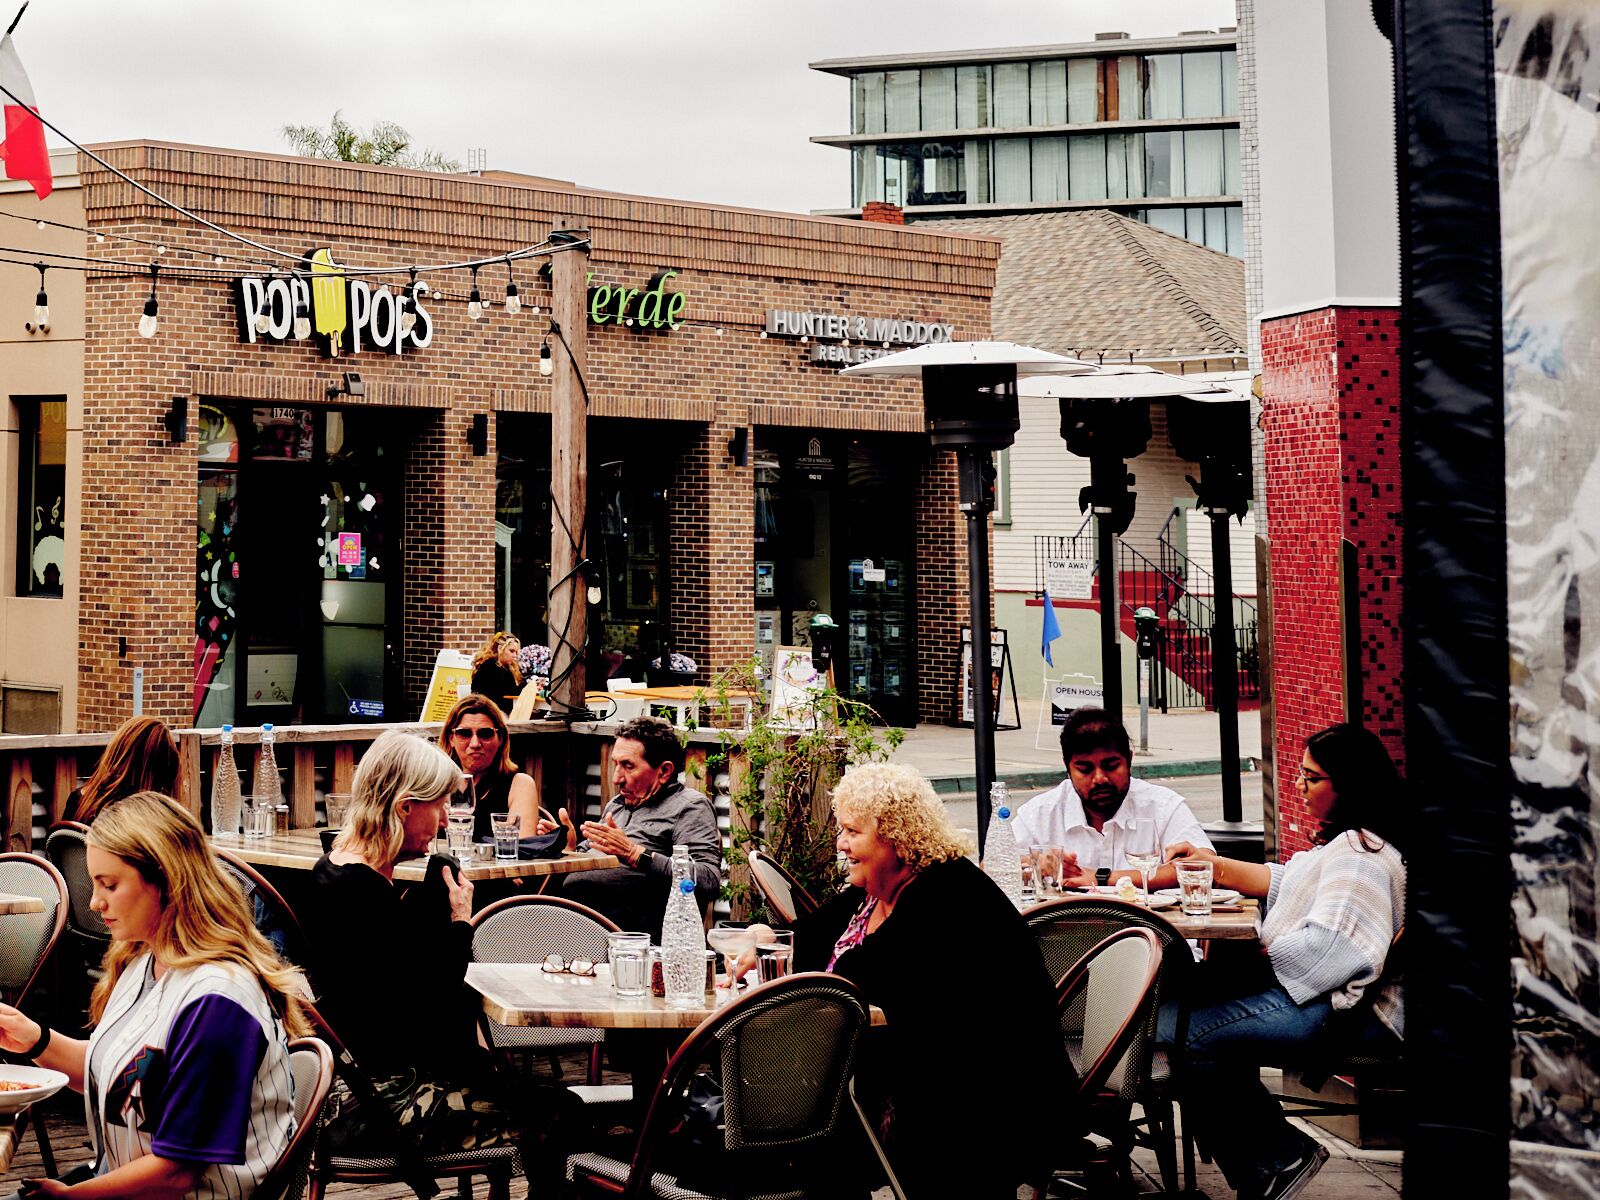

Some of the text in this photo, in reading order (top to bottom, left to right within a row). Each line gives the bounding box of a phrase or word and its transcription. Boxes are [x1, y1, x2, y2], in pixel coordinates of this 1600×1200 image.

[773, 310, 955, 343] HUNTER & MADDOX
[818, 344, 853, 363] REAL
[274, 408, 294, 418] 1740
[1048, 561, 1089, 570] TOW AWAY
[1056, 686, 1077, 695] OPEN
